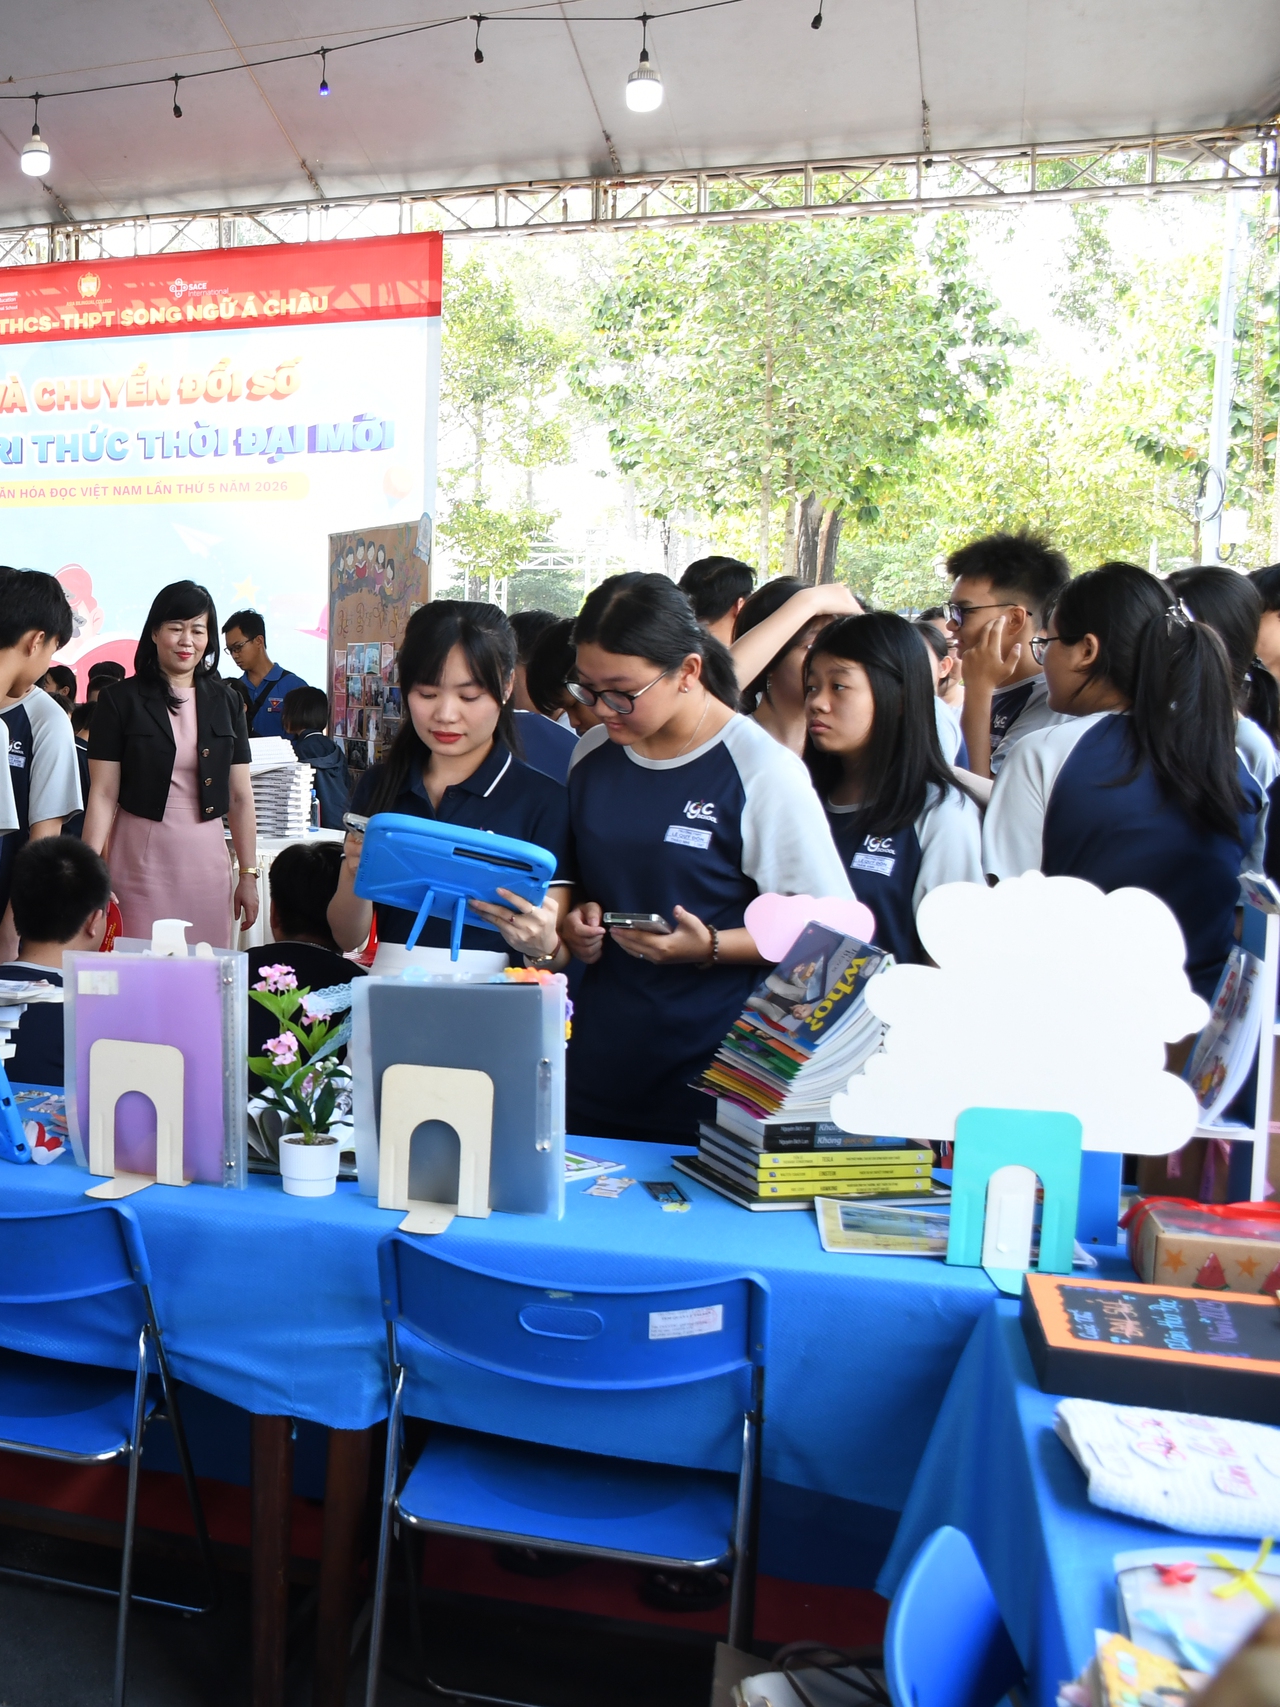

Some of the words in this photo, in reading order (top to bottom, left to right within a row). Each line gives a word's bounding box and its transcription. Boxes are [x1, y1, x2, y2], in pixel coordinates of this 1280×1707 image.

[188, 282, 207, 290] SACE
[188, 288, 229, 297] International
[121, 306, 182, 327] SONG
[187, 297, 238, 322] NGỮ
[241, 295, 258, 318] Á
[263, 292, 329, 316] CHÂU
[33, 362, 170, 411] CHUYỂN
[177, 357, 242, 405] ĐỔI
[245, 355, 304, 402] SỐ
[31, 424, 129, 462] THỨC
[137, 420, 230, 460] THỜI
[232, 424, 306, 465] ĐẠI
[307, 412, 396, 454] MỚI
[20, 485, 46, 499] HÓA
[49, 486, 77, 501] ĐỌC
[80, 485, 109, 501] VIỆT
[113, 484, 143, 497] NAM
[146, 480, 172, 496] LẦN
[176, 481, 204, 495] THỨ
[208, 482, 216, 494] 5
[220, 480, 251, 494] NĂM
[255, 480, 289, 493] 2026
[817, 1136, 842, 1146] Không
